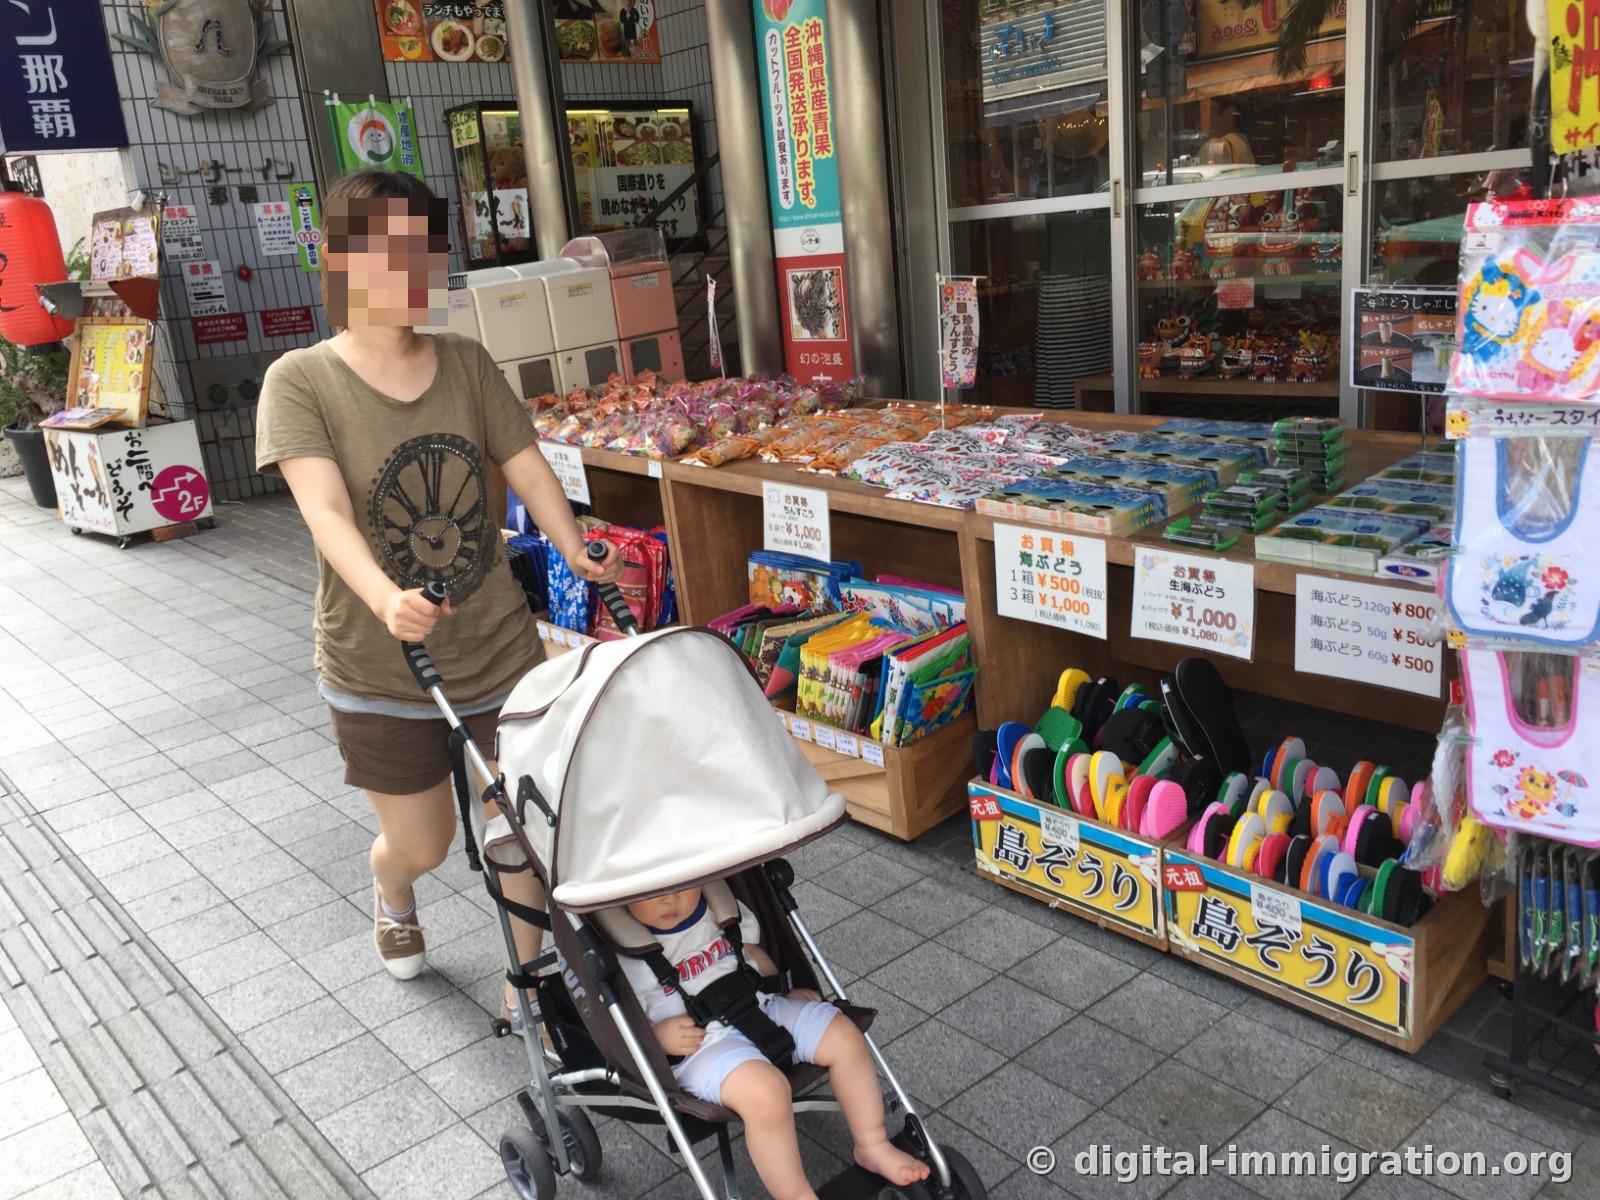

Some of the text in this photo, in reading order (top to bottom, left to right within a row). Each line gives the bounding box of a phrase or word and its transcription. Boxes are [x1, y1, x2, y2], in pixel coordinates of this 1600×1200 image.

[424, 4, 505, 18] ランチもやってま
[805, 20, 831, 156] 沖縄県産青果
[785, 26, 815, 205] 全国発送承ります。
[397, 110, 413, 166] 地産地消
[617, 174, 665, 192] 国際通りを
[1537, 208, 1564, 218] Kitty
[949, 314, 961, 372] ちんすこう
[799, 353, 843, 366] 幻の泡盛
[106, 458, 134, 522] どうぞ
[178, 490, 204, 514] 2F
[784, 505, 814, 518] ちんすこう
[785, 522, 821, 541] ¥1,000
[1021, 533, 1075, 557] お買得
[1019, 550, 1082, 576] 海ぶどう
[1173, 565, 1216, 584] お買得
[1037, 572, 1080, 594] ¥500
[1169, 579, 1225, 599] 生海ぶどう
[1038, 592, 1090, 616] ¥1,000
[1311, 588, 1436, 620] 海ぶどう 120g ¥800
[1171, 602, 1237, 631] ¥1,000
[1310, 614, 1362, 633] 海ぶどう
[1367, 627, 1388, 640] 50g
[1310, 637, 1434, 674] 海ぶどう 60g ¥500
[970, 799, 999, 815] 元祖
[993, 823, 1140, 910] 島ぞうり
[1165, 868, 1204, 887] 元祖
[1191, 895, 1384, 1005] 島ぞうり
